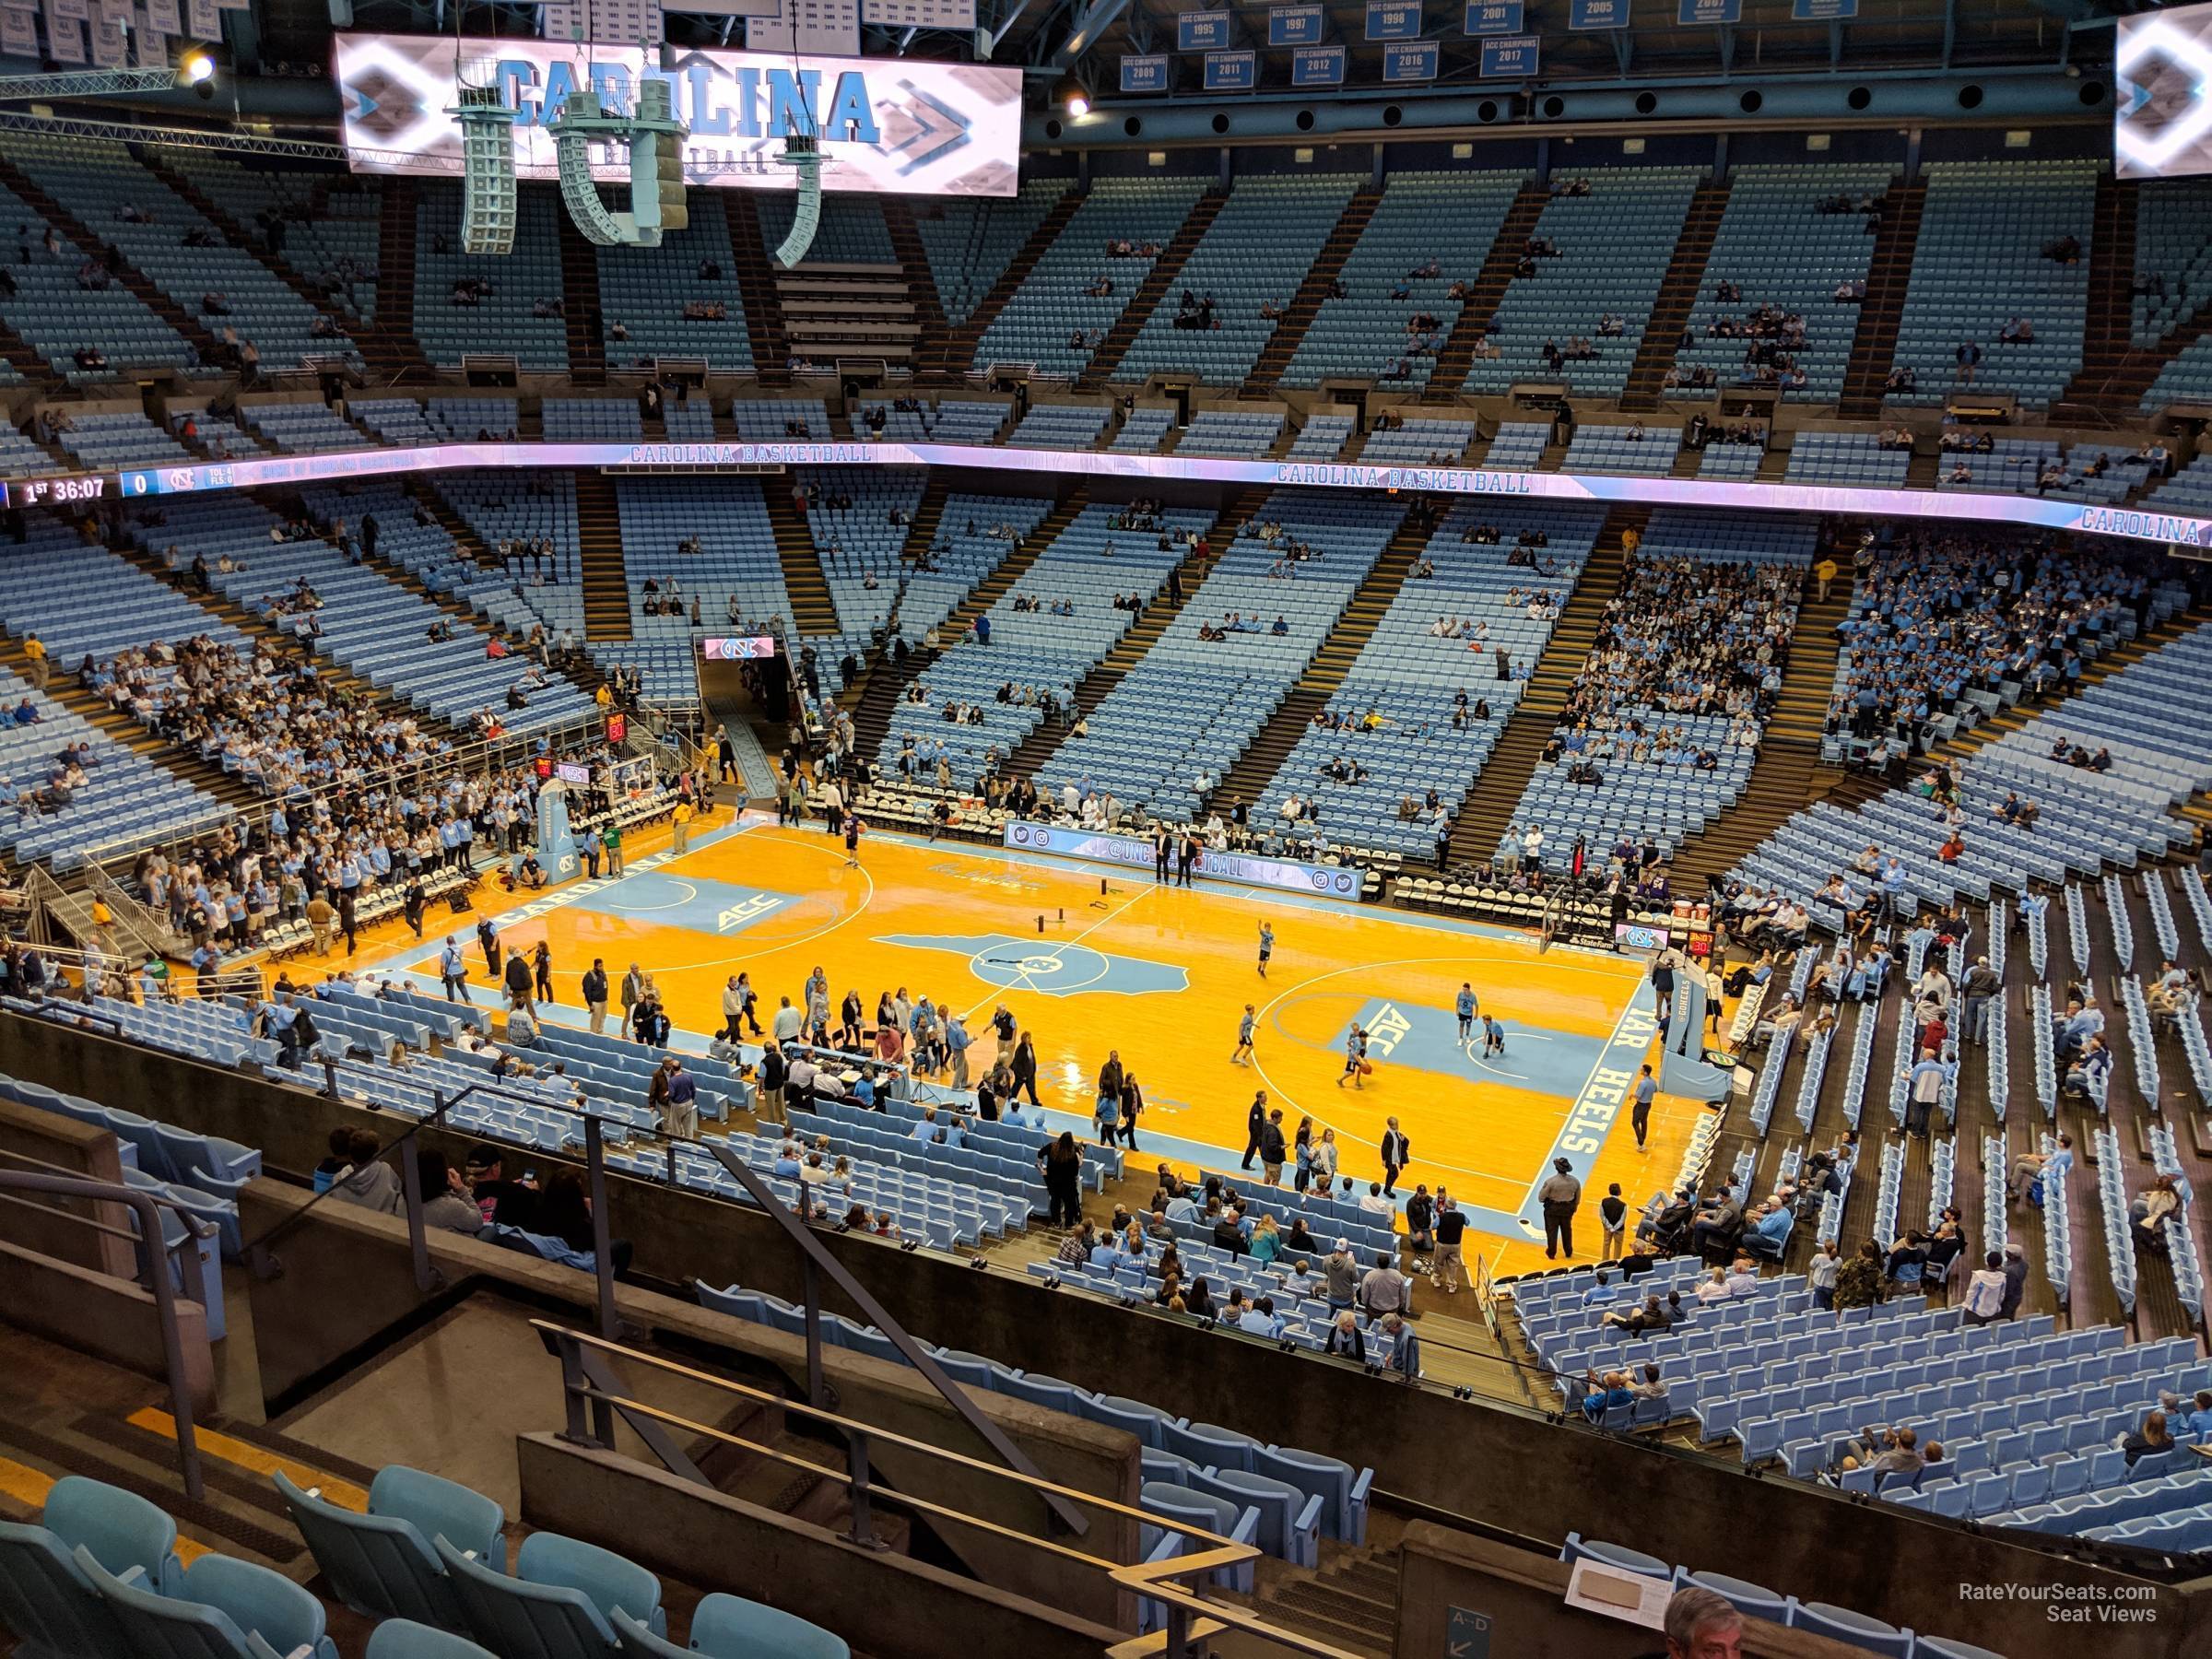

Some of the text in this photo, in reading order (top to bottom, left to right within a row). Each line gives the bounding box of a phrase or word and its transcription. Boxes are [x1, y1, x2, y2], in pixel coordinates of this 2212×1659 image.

[1483, 7, 1506, 19] 2001
[1586, 2, 1613, 14] 2005
[1286, 18, 1306, 29] 1997
[1382, 13, 1405, 24] 1998
[1194, 24, 1215, 35] 1995
[1499, 50, 1521, 62] 2017
[1219, 65, 1239, 75] 2011
[1307, 60, 1329, 71] 2012
[630, 446, 872, 463] CAROLINA BASKETBALL
[135, 475, 147, 493] 0
[1277, 465, 1530, 493] CAROLINA BASKETBALL
[55, 479, 103, 500] 36:07
[2081, 508, 2199, 544] CAROLINA
[718, 893, 779, 929] ACC
[1560, 1007, 1657, 1154] TAR HEELS
